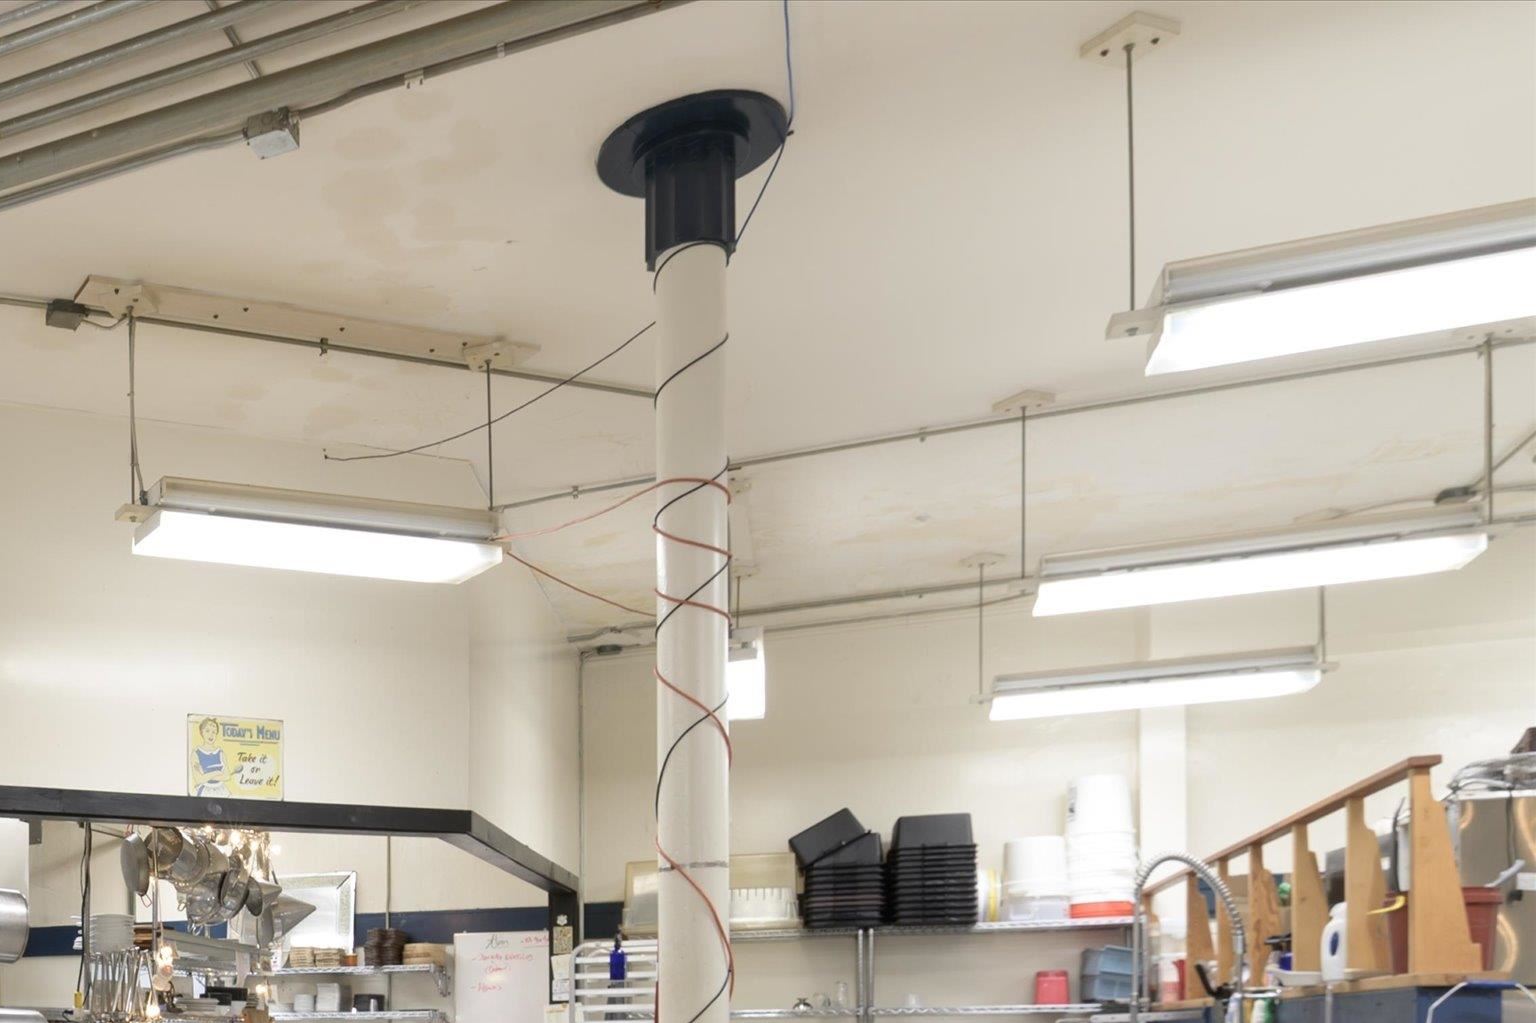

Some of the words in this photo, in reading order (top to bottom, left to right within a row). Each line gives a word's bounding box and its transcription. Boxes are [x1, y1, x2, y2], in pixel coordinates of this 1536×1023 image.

[257, 725, 281, 740] MENU
[237, 751, 257, 763] Take
[259, 753, 268, 764] it
[250, 766, 261, 774] or
[239, 773, 263, 785] Leave
[265, 775, 280, 787] it!
